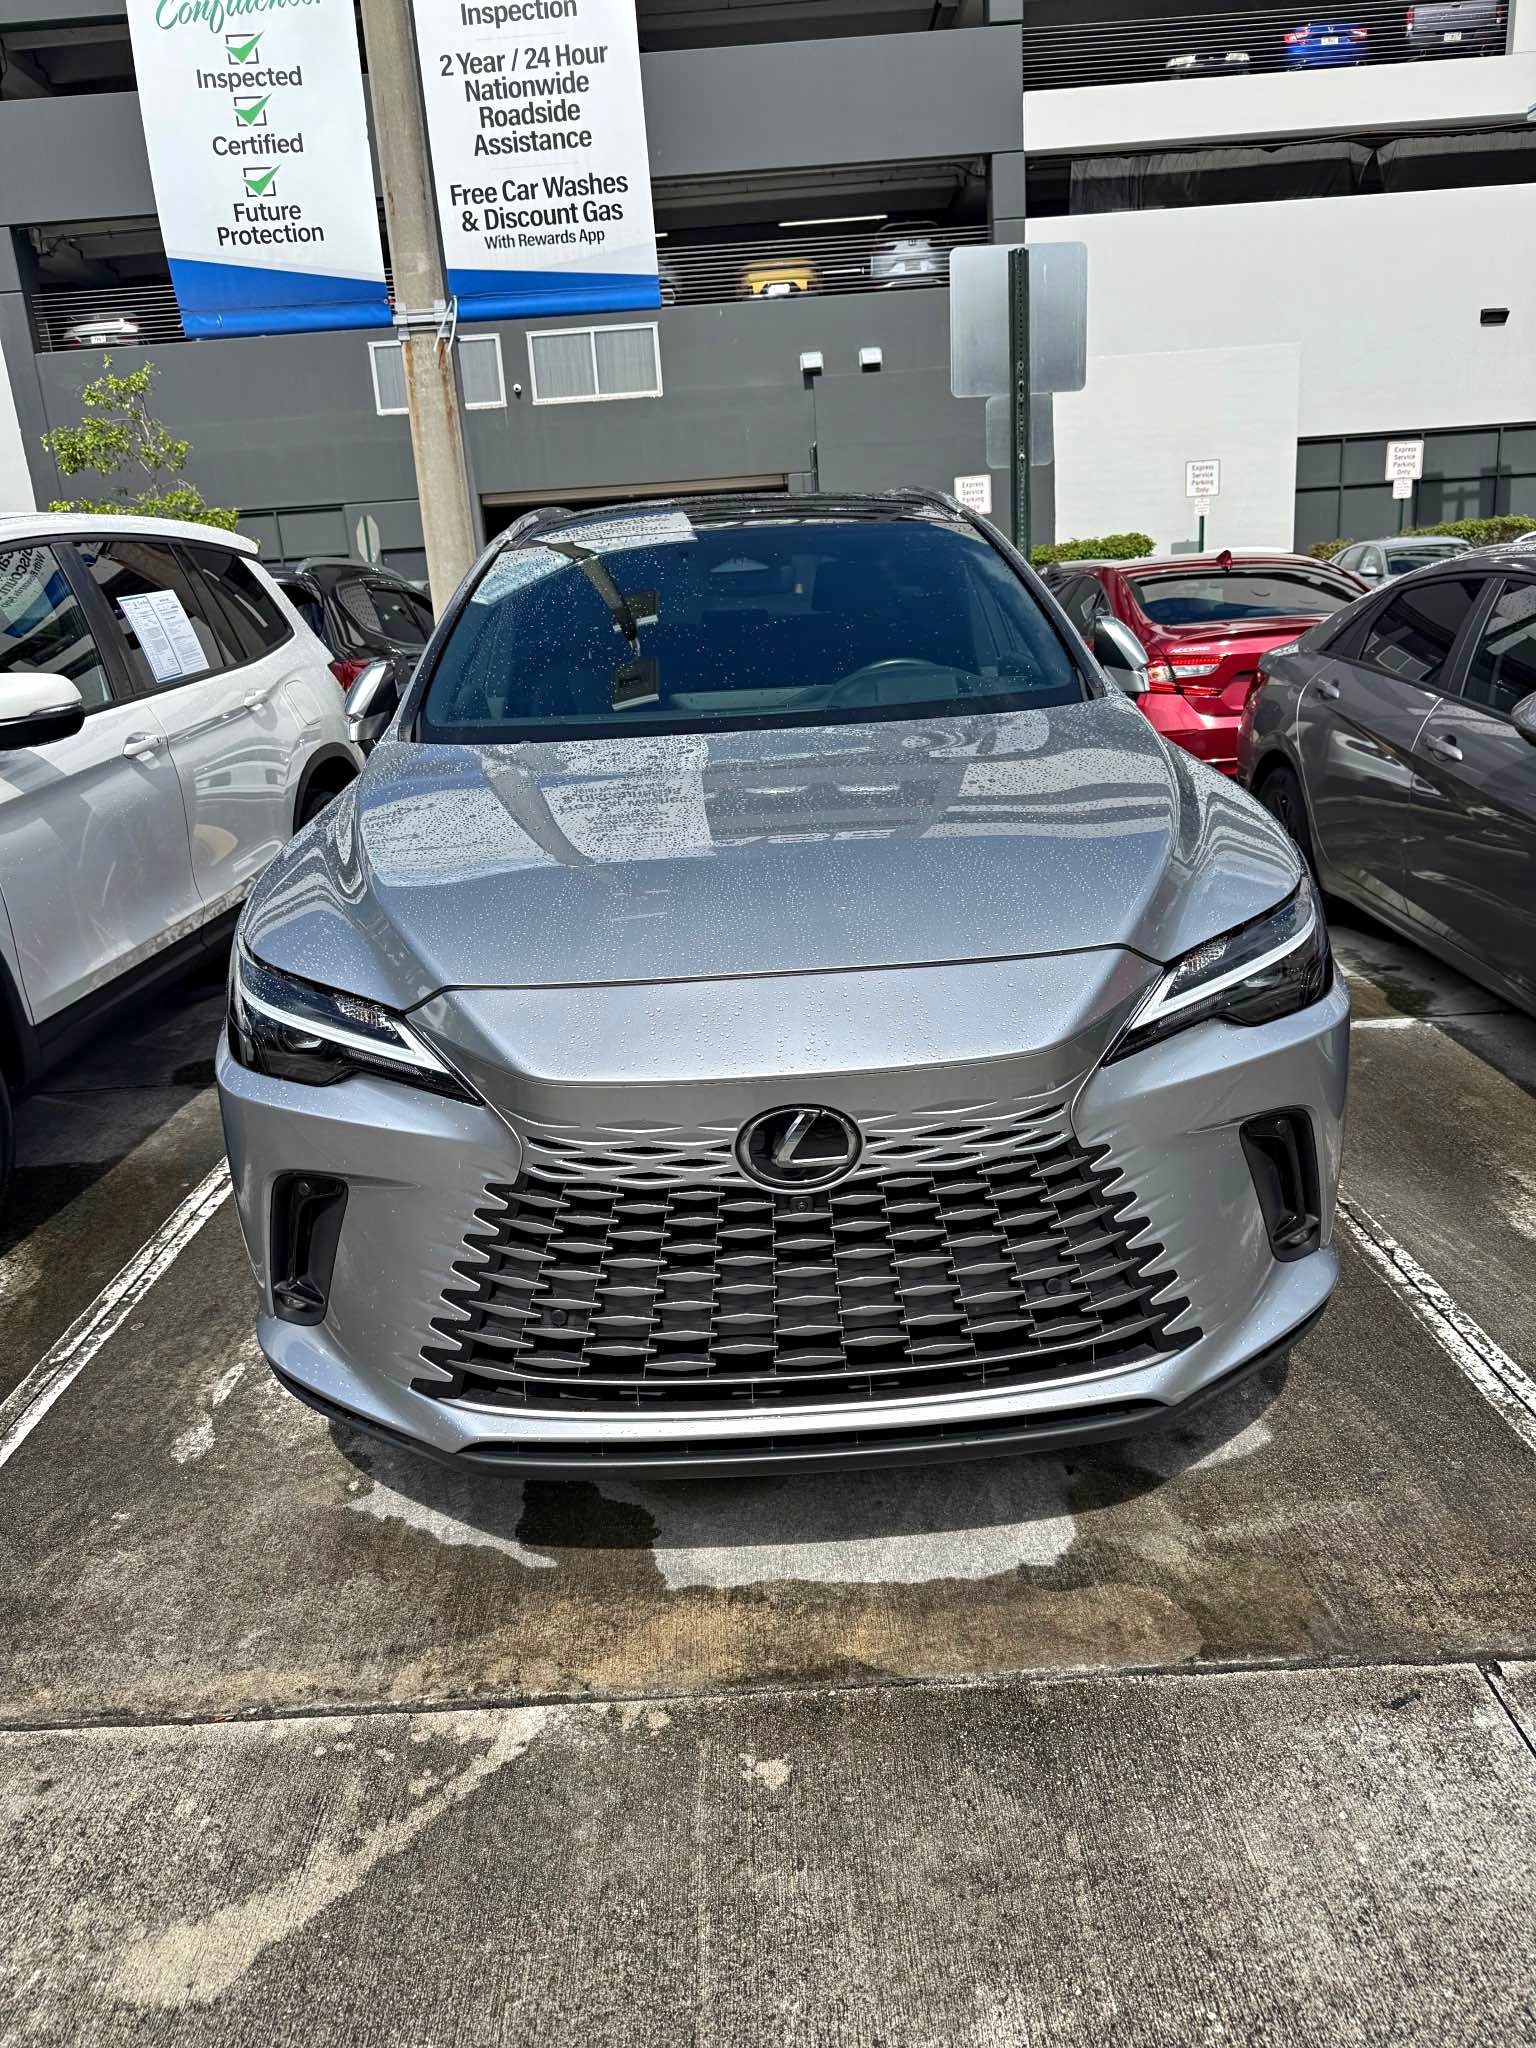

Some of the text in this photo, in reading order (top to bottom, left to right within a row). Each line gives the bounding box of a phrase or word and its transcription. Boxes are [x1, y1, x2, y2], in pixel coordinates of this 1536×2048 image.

[155, 0, 322, 33] Confide
[459, 0, 578, 29] Inspection
[440, 45, 607, 76] 2 Year / 24 Hour
[197, 66, 302, 92] Inspected
[464, 71, 590, 102] Nationwide
[479, 99, 581, 128] Roadside
[213, 133, 303, 155] Certified
[475, 131, 592, 156] Assistance
[450, 173, 628, 206] Free Car Washes
[234, 203, 301, 222] Future
[462, 201, 623, 232] & Discount Gas
[217, 223, 324, 246] Protection
[484, 229, 605, 249] With Rewards App
[1393, 461, 1415, 469] Parking
